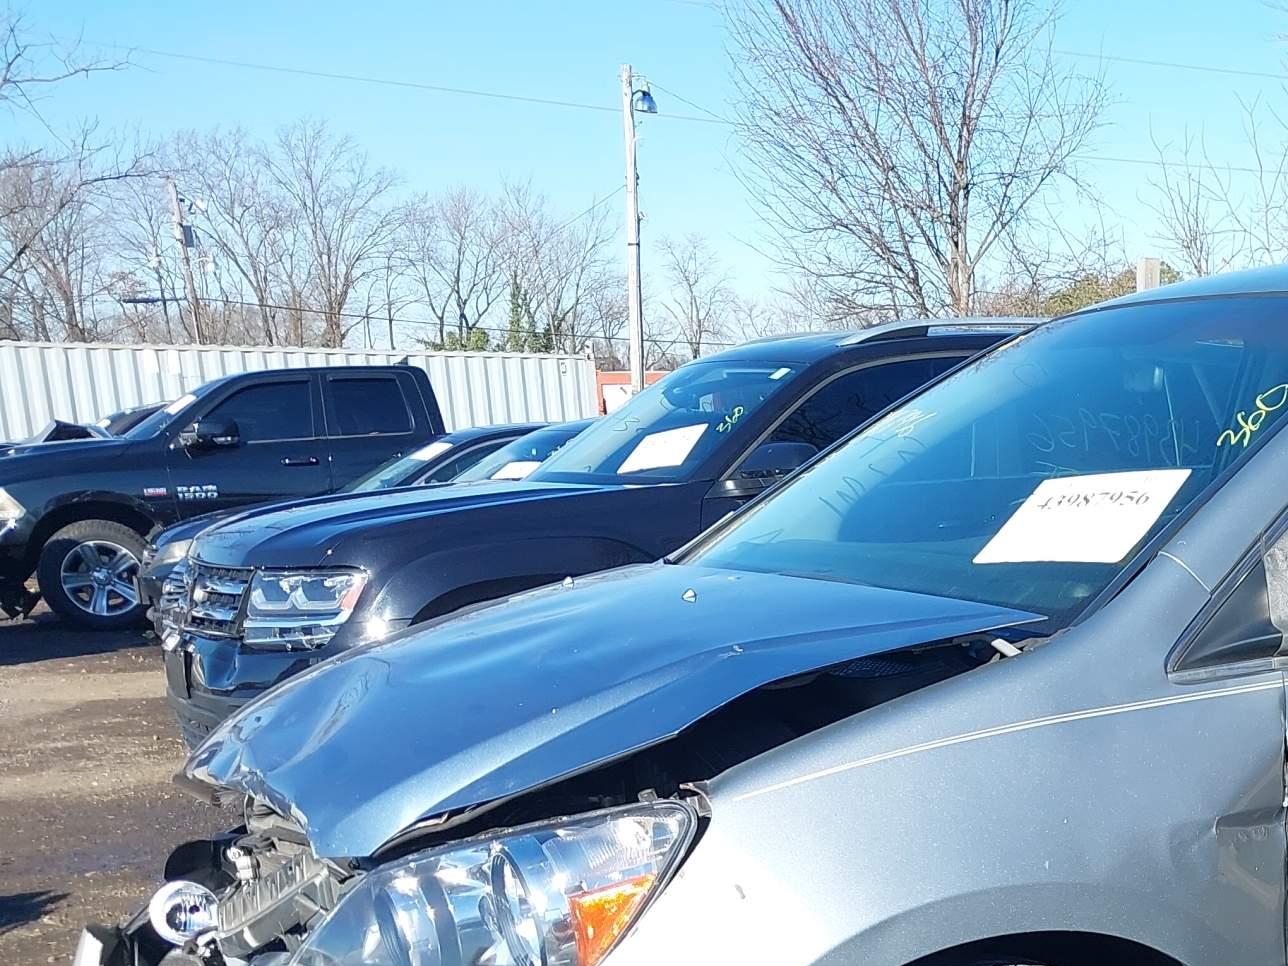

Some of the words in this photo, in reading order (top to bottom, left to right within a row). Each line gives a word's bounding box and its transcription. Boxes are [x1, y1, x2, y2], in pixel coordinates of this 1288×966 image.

[715, 406, 744, 433] 360
[176, 485, 217, 493] RAM
[177, 492, 219, 500] 1500
[1037, 490, 1150, 510] 43987956
